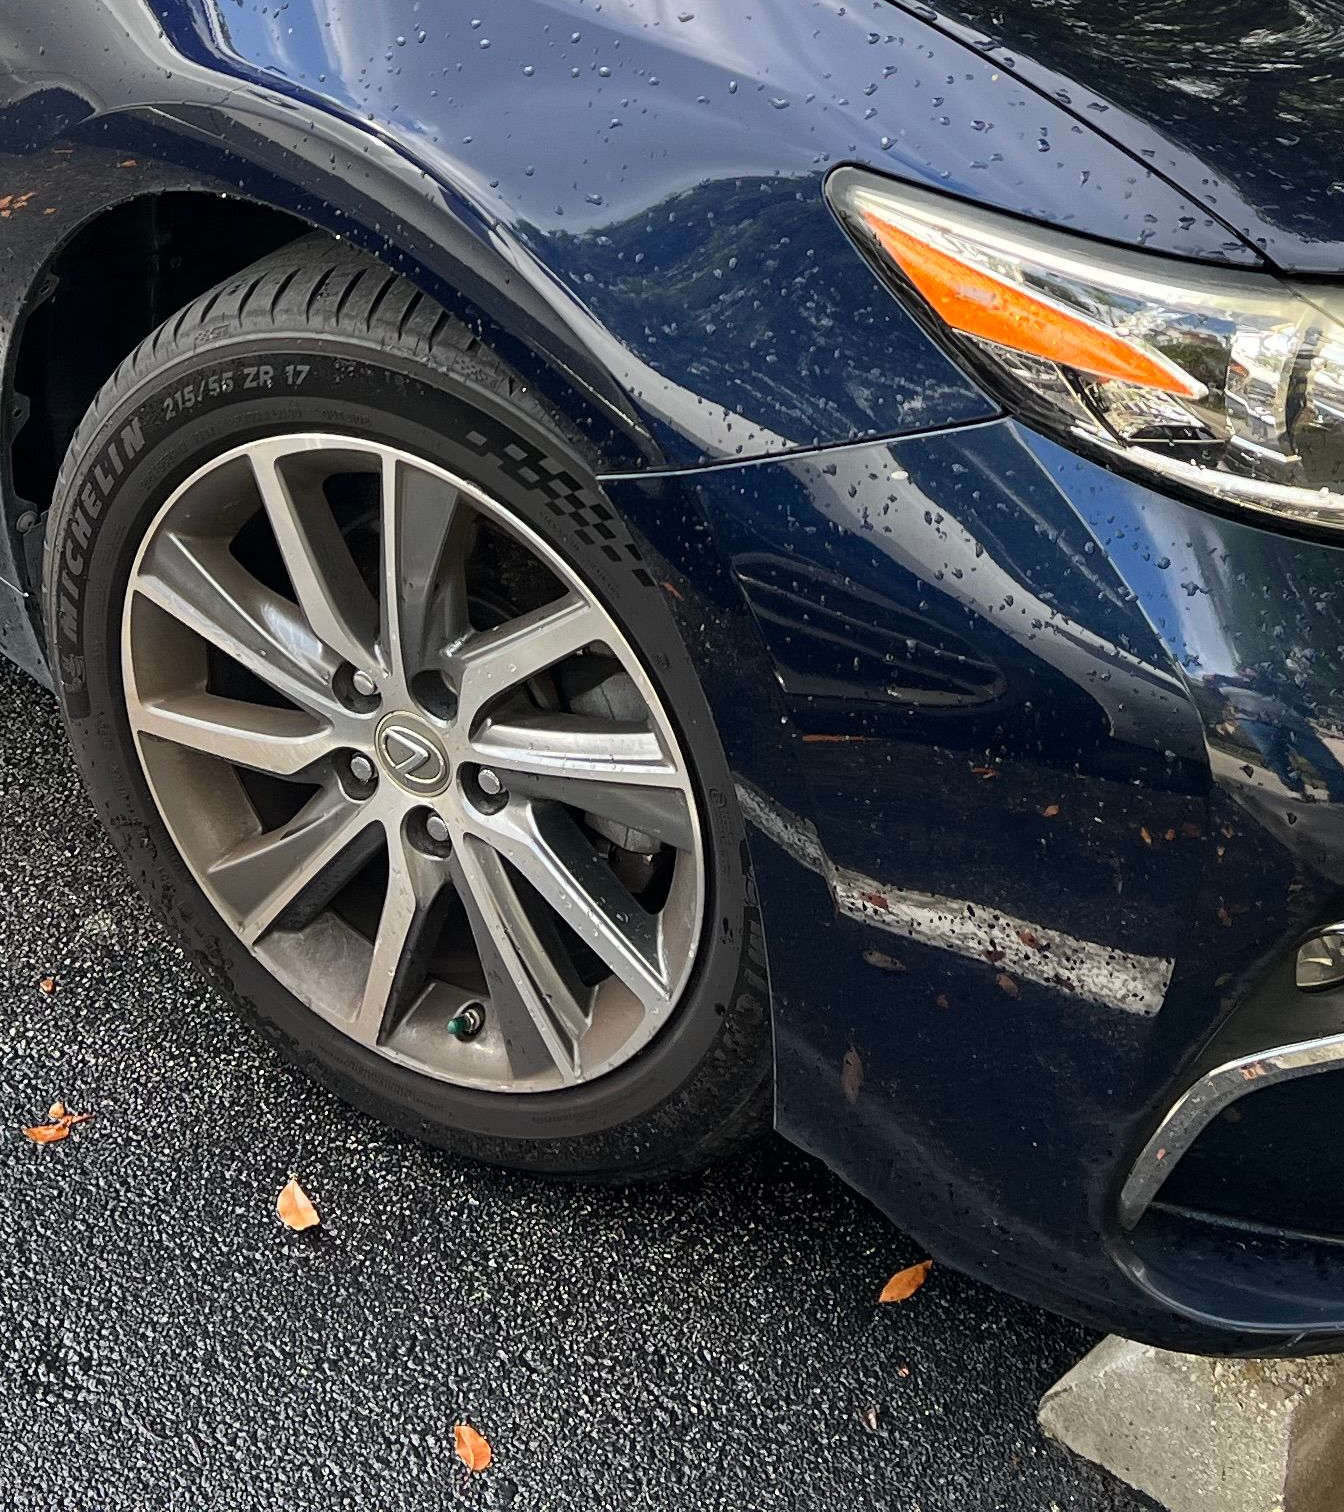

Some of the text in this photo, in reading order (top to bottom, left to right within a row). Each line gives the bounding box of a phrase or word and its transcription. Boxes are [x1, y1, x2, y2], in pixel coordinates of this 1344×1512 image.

[163, 371, 234, 421] 215/55
[243, 365, 274, 389] ZR
[286, 365, 310, 385] 17
[59, 416, 146, 644] MICHELIN
